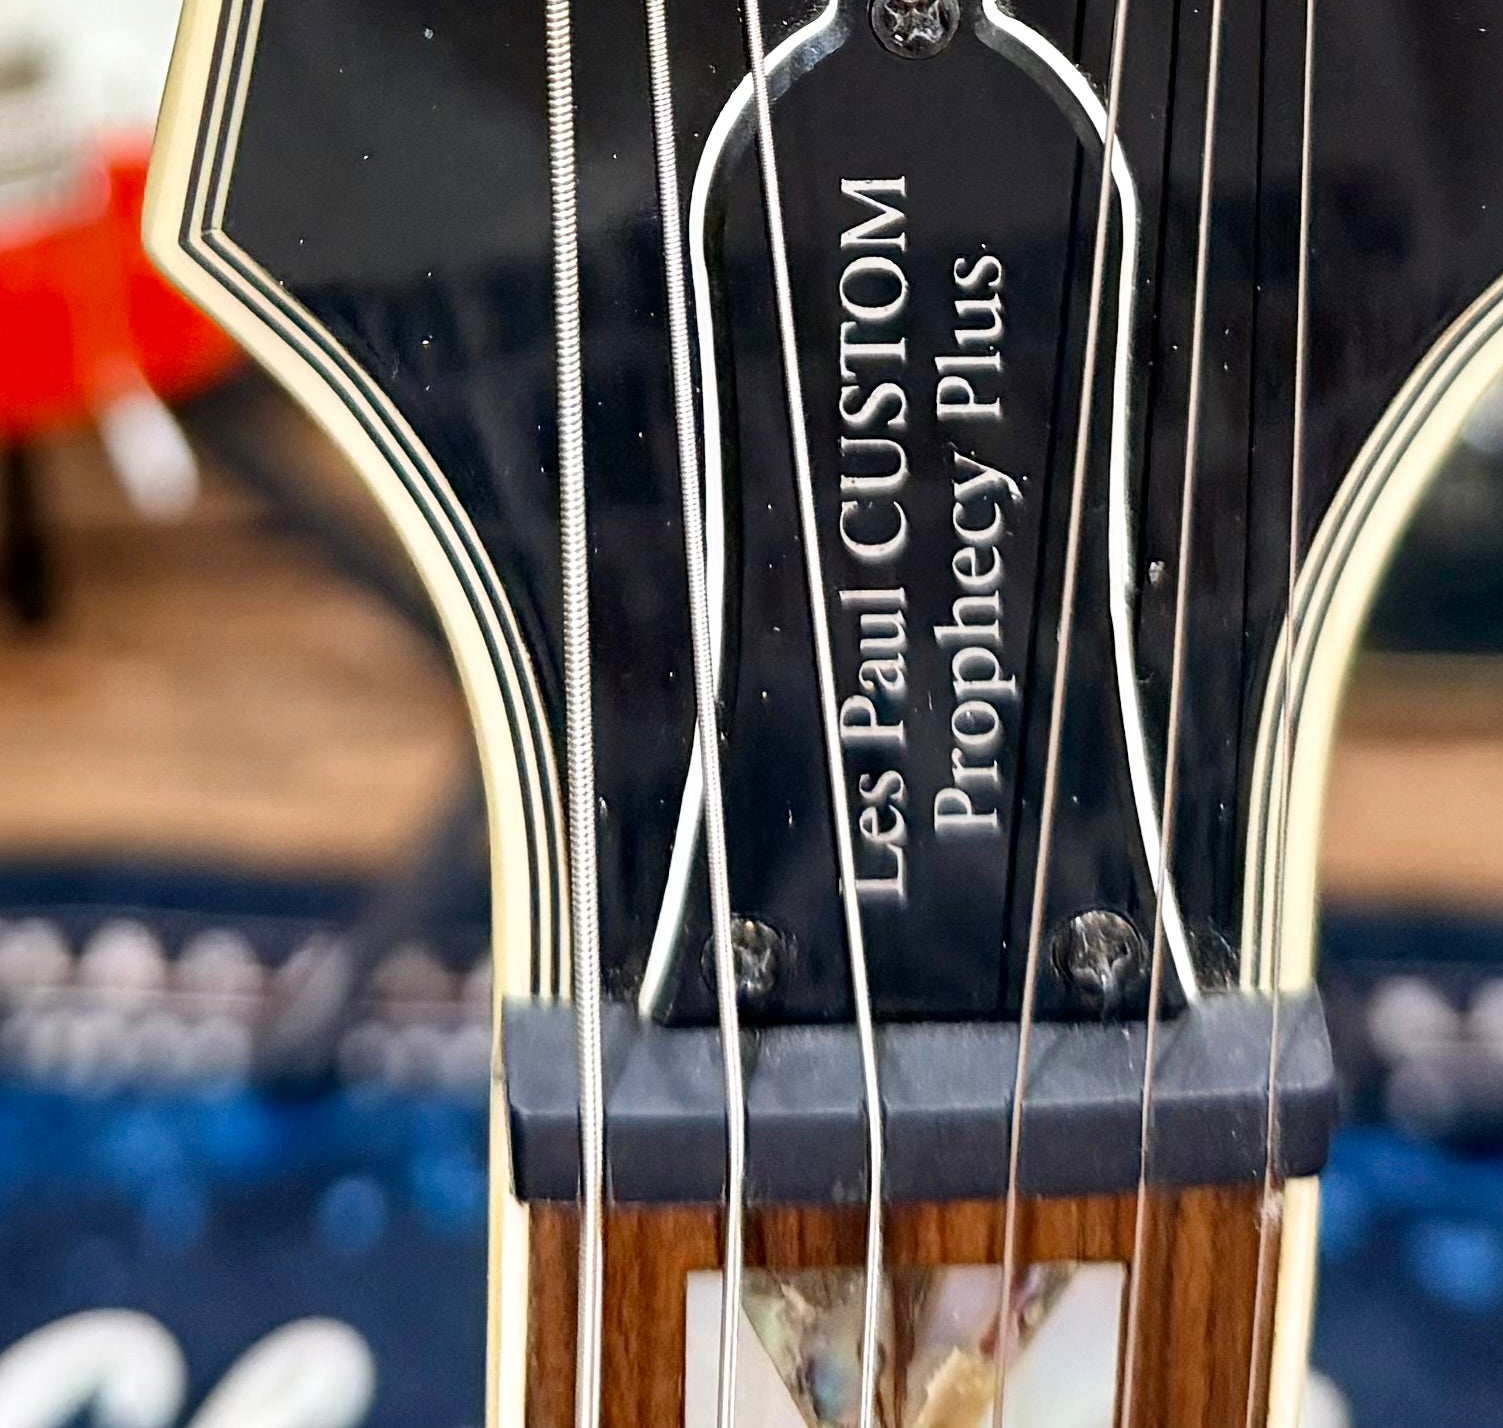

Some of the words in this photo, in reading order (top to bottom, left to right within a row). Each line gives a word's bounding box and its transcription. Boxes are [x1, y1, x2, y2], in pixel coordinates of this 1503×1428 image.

[839, 174, 909, 562] CUSTOM
[934, 254, 1003, 421] Plus
[839, 585, 908, 746] Paul
[933, 451, 1022, 836] Prophecy
[838, 769, 908, 898] Les
